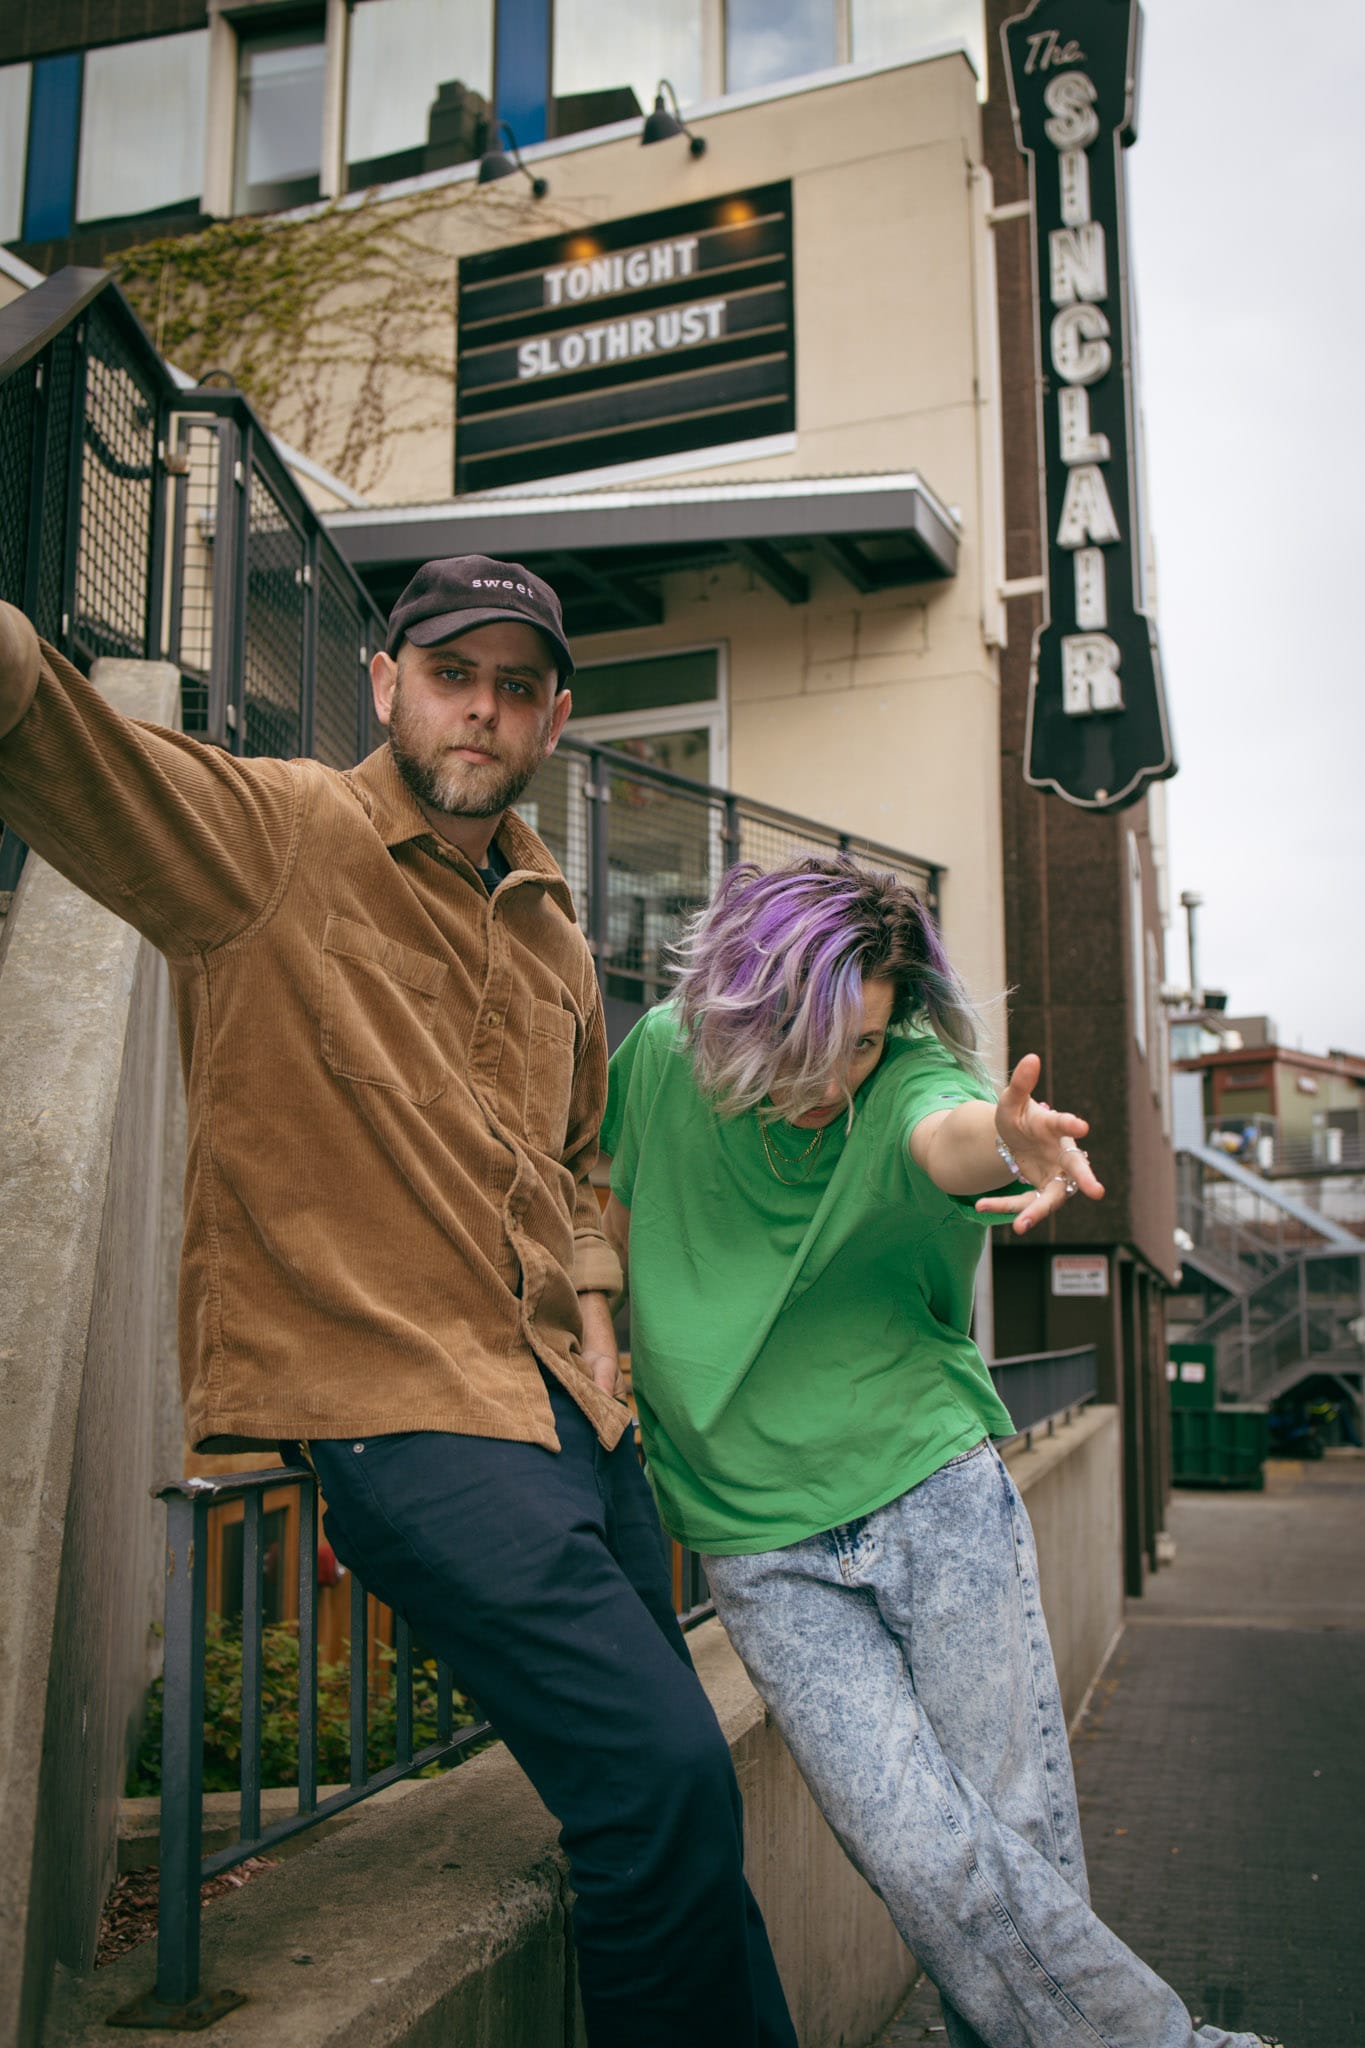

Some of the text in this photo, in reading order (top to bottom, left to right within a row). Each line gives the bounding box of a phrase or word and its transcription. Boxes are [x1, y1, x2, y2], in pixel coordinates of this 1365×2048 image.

[1024, 29, 1087, 74] The
[544, 238, 698, 305] TONIGHT
[517, 301, 727, 379] SLOTHRUST
[1043, 70, 1125, 716] SINCLAIR
[472, 579, 534, 599] sweet
